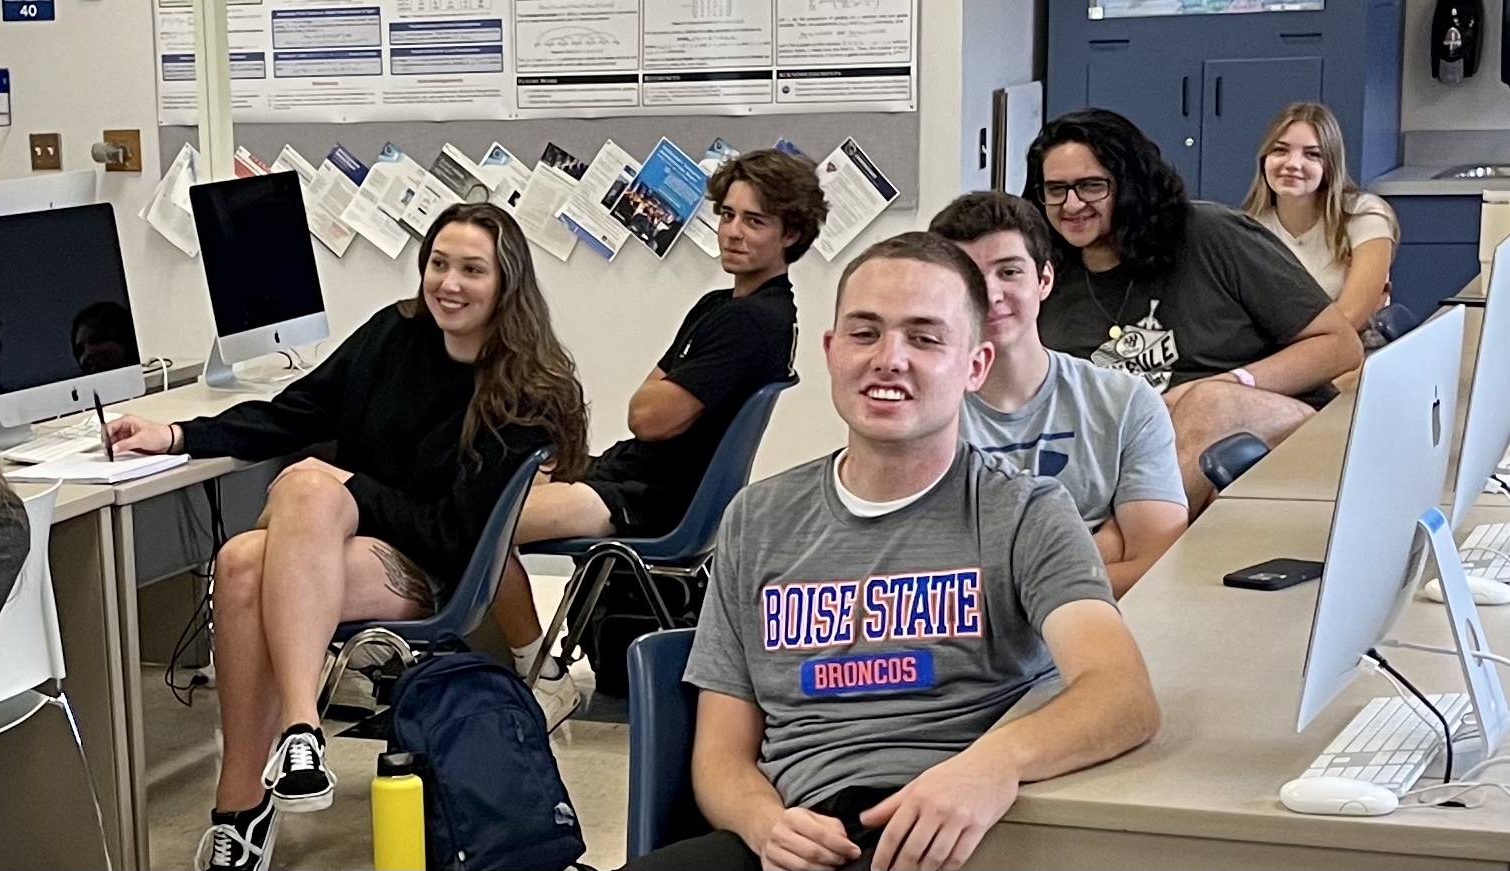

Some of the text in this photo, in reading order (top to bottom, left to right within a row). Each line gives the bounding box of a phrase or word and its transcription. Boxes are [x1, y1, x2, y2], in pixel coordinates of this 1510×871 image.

[20, 4, 37, 17] 40
[763, 567, 982, 651] BOISE STATE
[814, 656, 918, 690] BRONCOS
